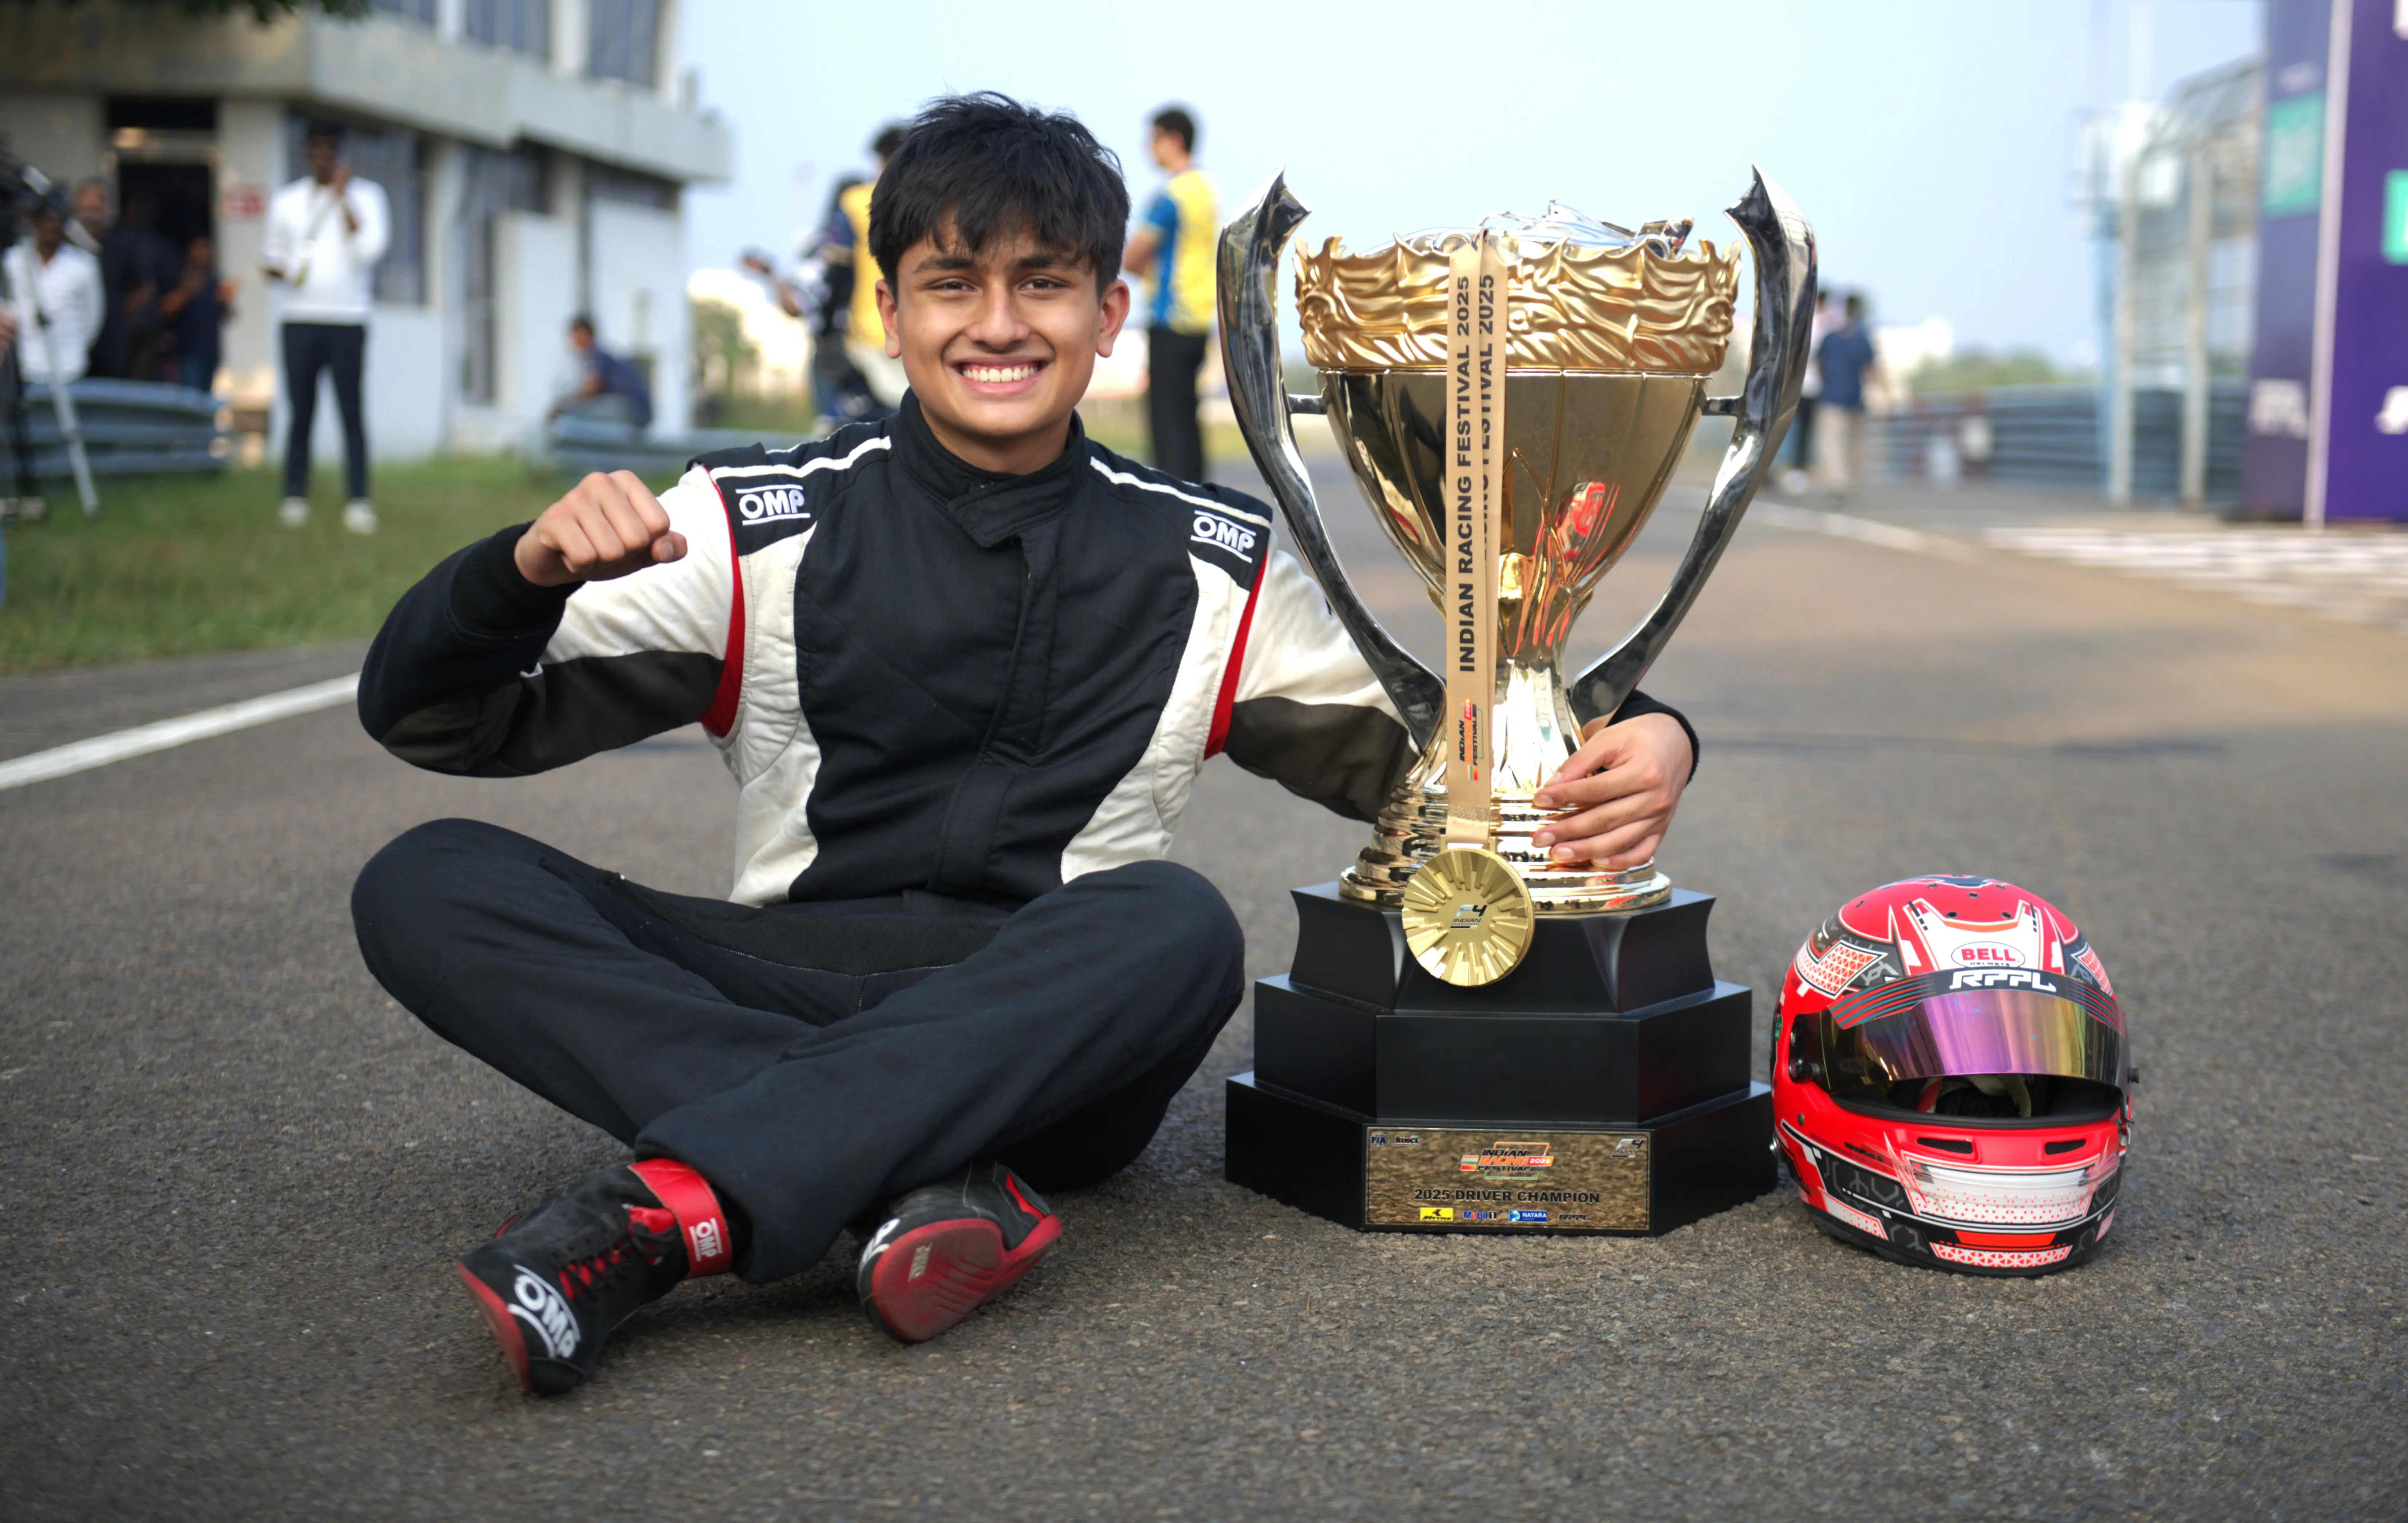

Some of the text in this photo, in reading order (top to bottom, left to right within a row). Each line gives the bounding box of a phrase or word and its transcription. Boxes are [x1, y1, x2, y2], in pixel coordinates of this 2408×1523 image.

[1479, 274, 1494, 335] 2025
[1457, 276, 1475, 672] INDIAN RACING FESTIVAL 2025
[739, 489, 805, 519] OMP
[1193, 516, 1255, 552] OMP
[1456, 904, 1487, 917] F4
[1961, 948, 2016, 961] BELL
[1949, 969, 2057, 992] RPPL
[1479, 1156, 1529, 1166] RACING
[1414, 1189, 1600, 1203] 2025 DRIVER CHAMPION
[1463, 1210, 1487, 1219] Mobil
[696, 1221, 717, 1257] OMP
[514, 1274, 576, 1358] OMP
